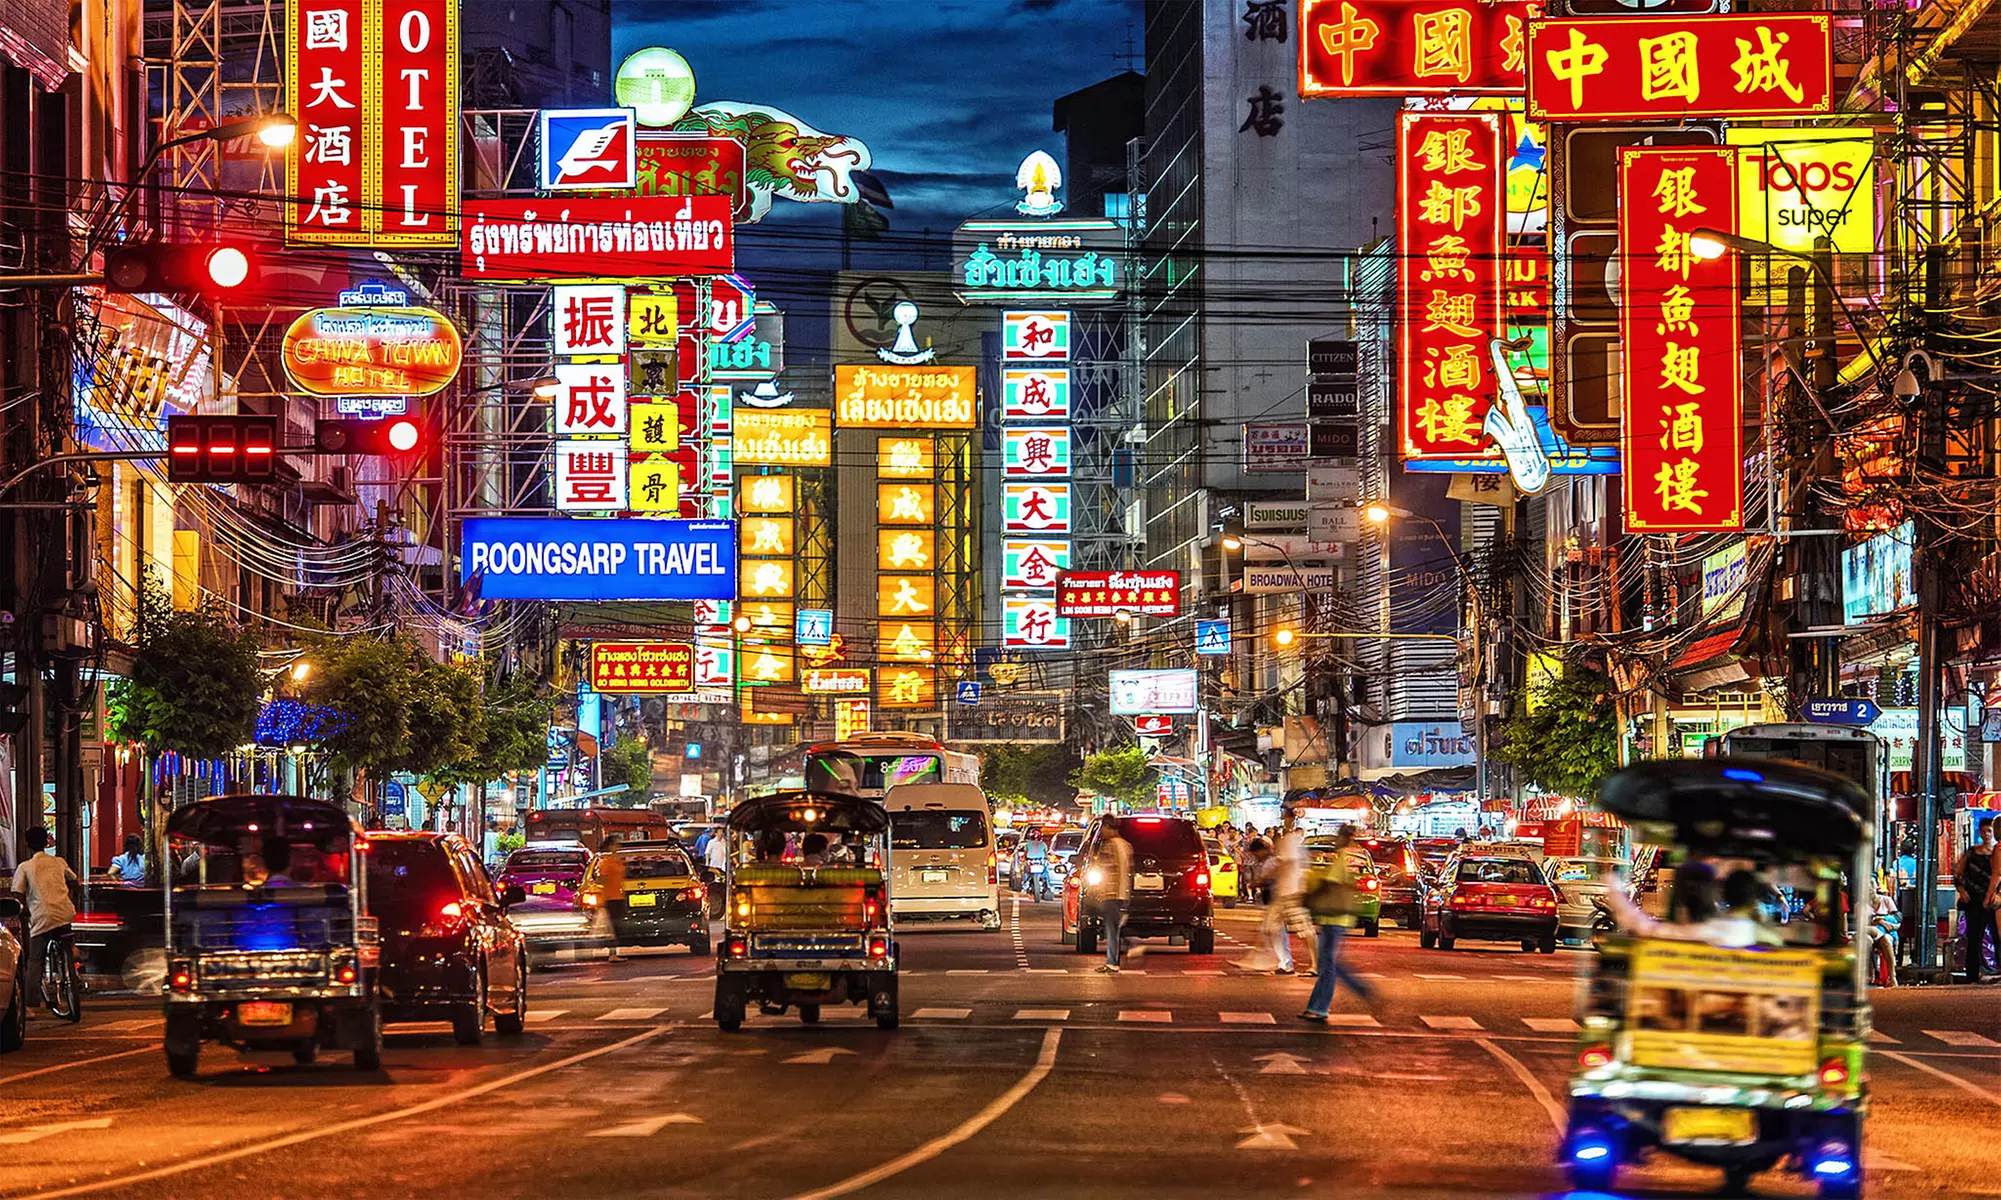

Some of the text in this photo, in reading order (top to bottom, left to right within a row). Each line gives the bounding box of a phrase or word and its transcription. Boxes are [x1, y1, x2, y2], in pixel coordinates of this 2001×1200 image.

[1545, 25, 1805, 111] 中國城
[1746, 155, 1855, 206] Tops
[470, 196, 724, 272] รุ่งทรัพย์การท่องเที่ยว
[1777, 206, 1853, 233] super
[1413, 128, 1487, 446] 銀都魚翅酒樓
[293, 339, 373, 364] CHINA
[1651, 166, 1709, 516] 銀都魚翅酒樓
[1311, 352, 1355, 363] CITIZEN
[563, 295, 617, 505] 振成豐
[1312, 392, 1356, 404] RADO
[1317, 433, 1351, 444] MIDO
[1019, 320, 1054, 641] 和成興大金行
[1321, 517, 1347, 525] BALL
[472, 541, 726, 575] ROONGSARP TRAVEL
[1250, 574, 1304, 587] BROADWAY
[1857, 704, 1867, 718] 2
